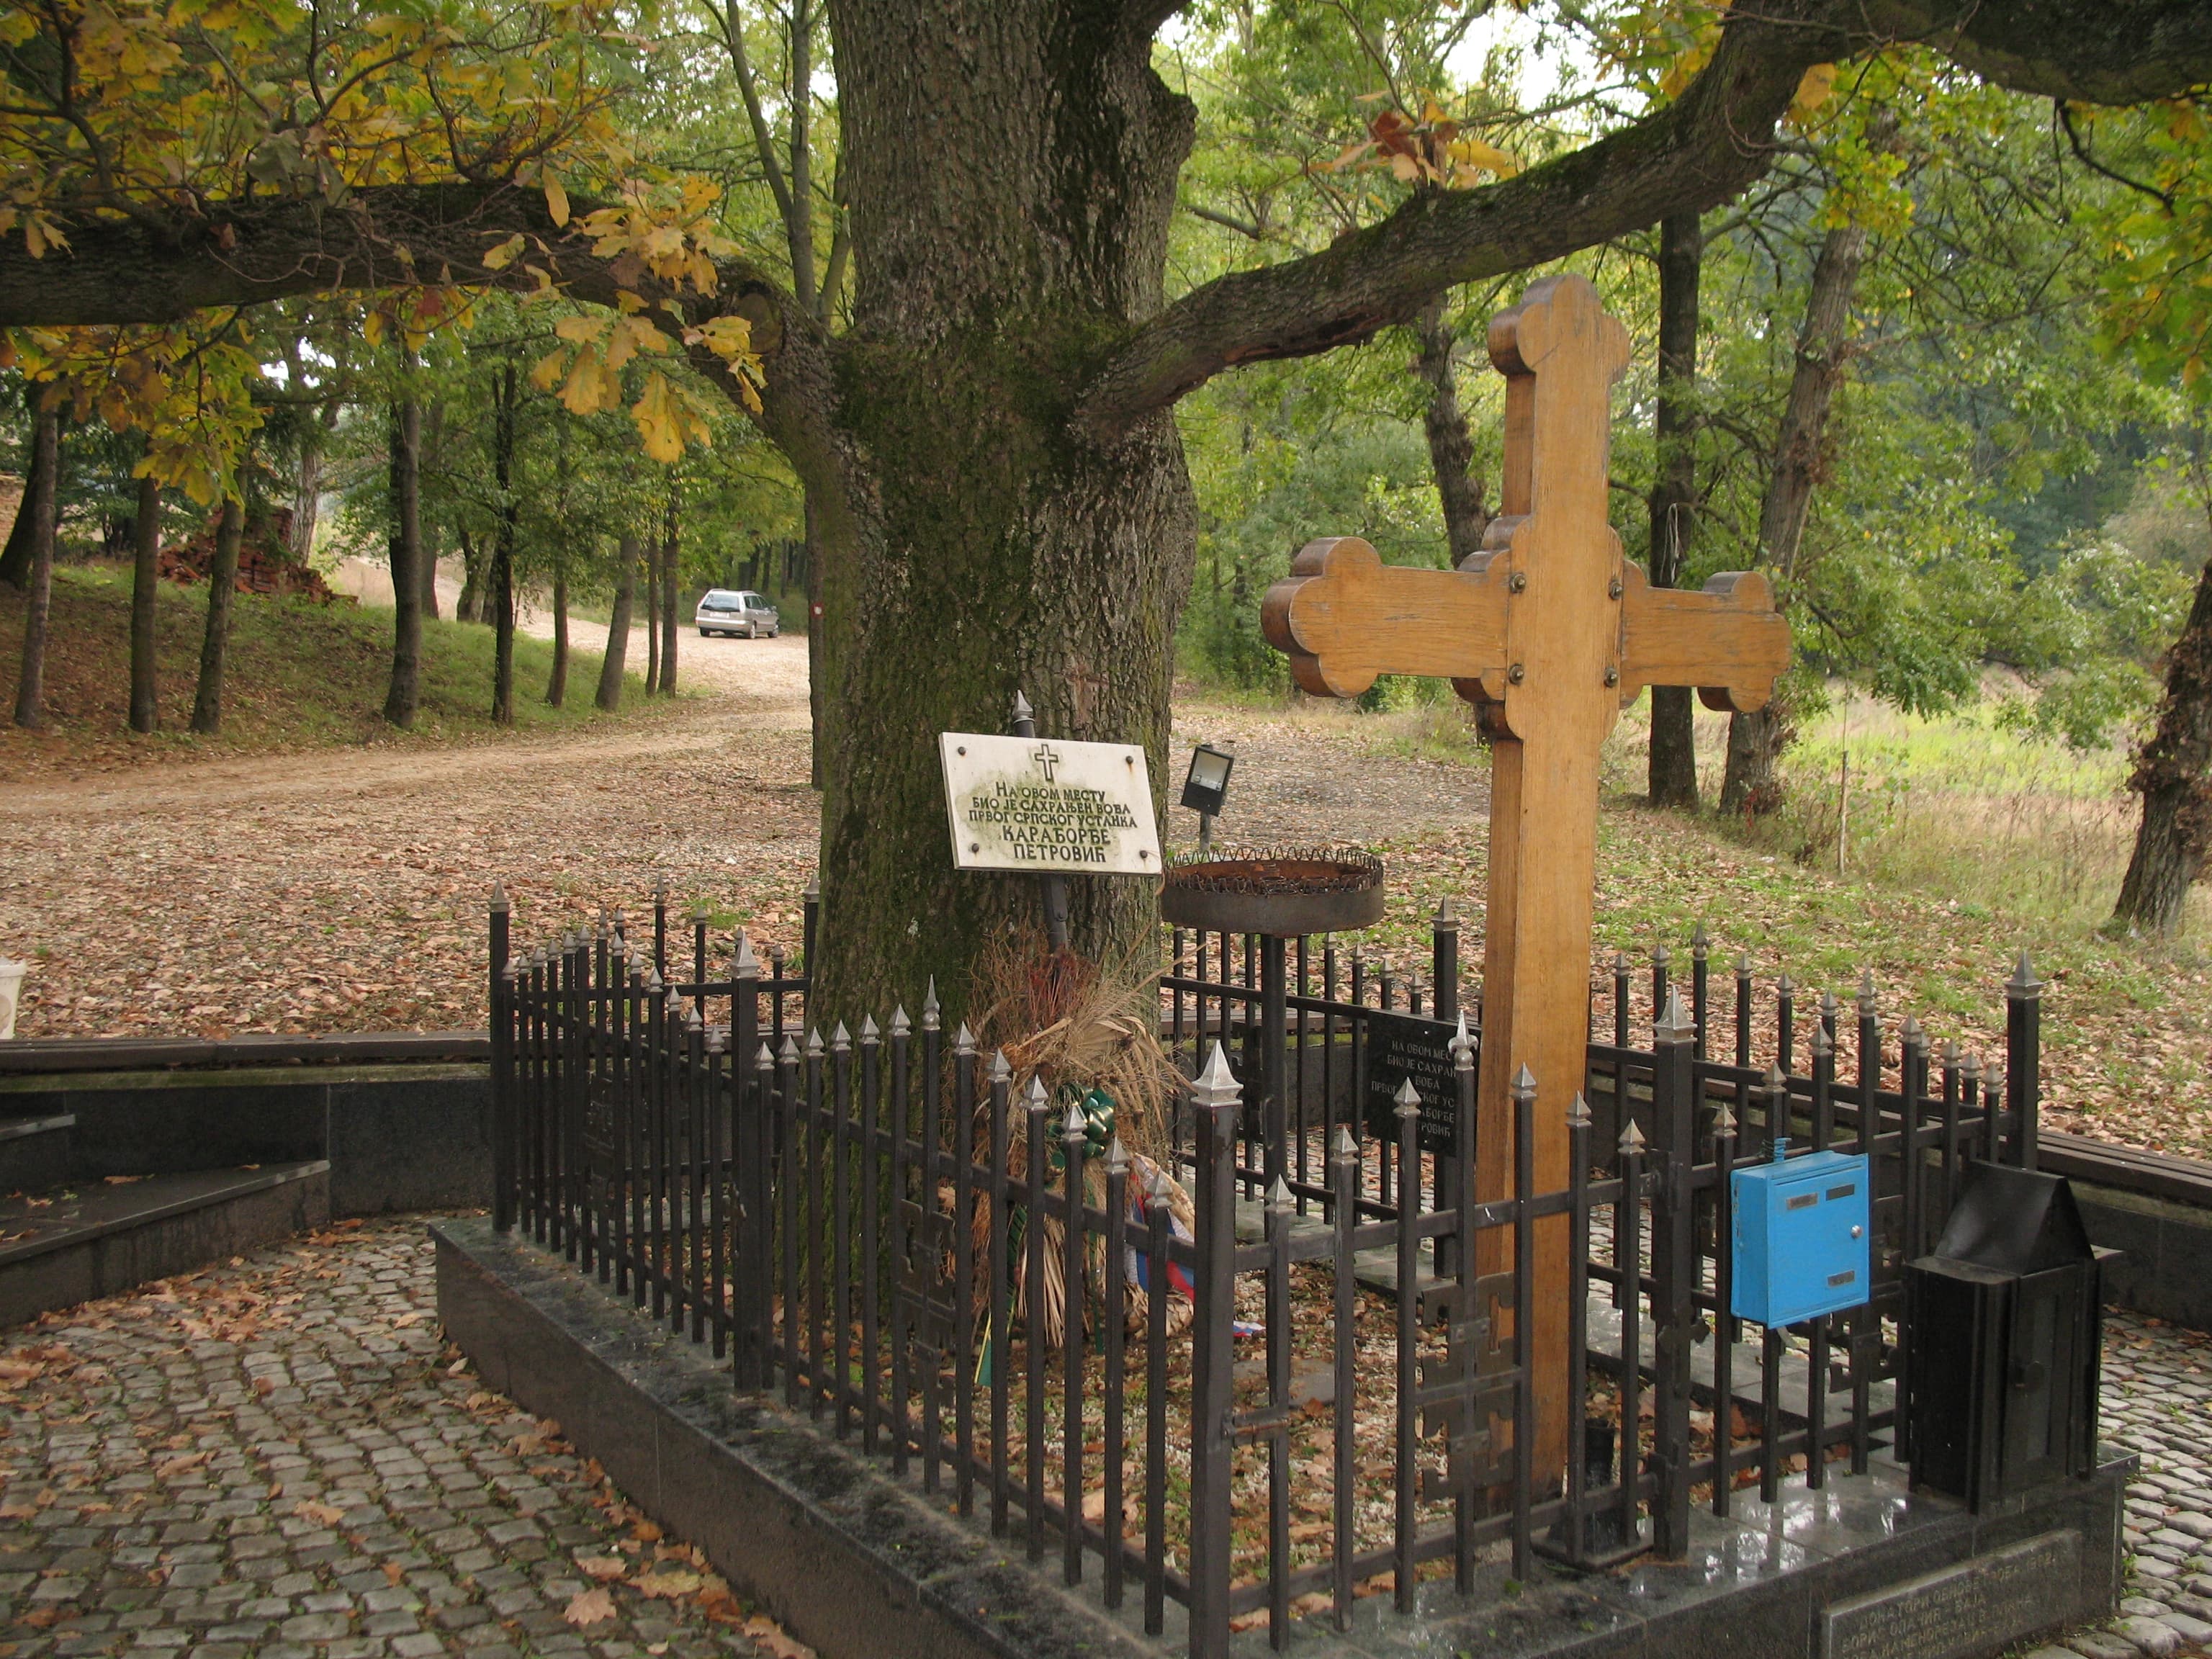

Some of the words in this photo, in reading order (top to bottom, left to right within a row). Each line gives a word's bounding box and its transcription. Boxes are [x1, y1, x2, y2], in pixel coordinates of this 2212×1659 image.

[1021, 787, 1059, 800] ОВОМ
[1064, 789, 1105, 802] МЕСТУ
[972, 797, 999, 809] БИО
[1003, 799, 1017, 811] ЈЕ
[1020, 799, 1093, 814] САХРАЊЕН
[1097, 803, 1130, 815] ВОЂА
[968, 810, 1011, 823] ПРВОГ
[1014, 812, 1074, 826] СРПСКОГ
[1076, 814, 1138, 829] УСТАНКА
[1002, 825, 1111, 845] КАРАЂОРЂЕ
[1013, 843, 1107, 863] ПЕТРОВИЋ
[1391, 1040, 1405, 1052] НА
[1406, 1043, 1431, 1057] ОВОМ
[1433, 1048, 1451, 1061] МЕС
[1387, 1054, 1404, 1066] БИО
[1406, 1058, 1416, 1069] ЈЕ
[1371, 1081, 1398, 1094] ПРВОГ
